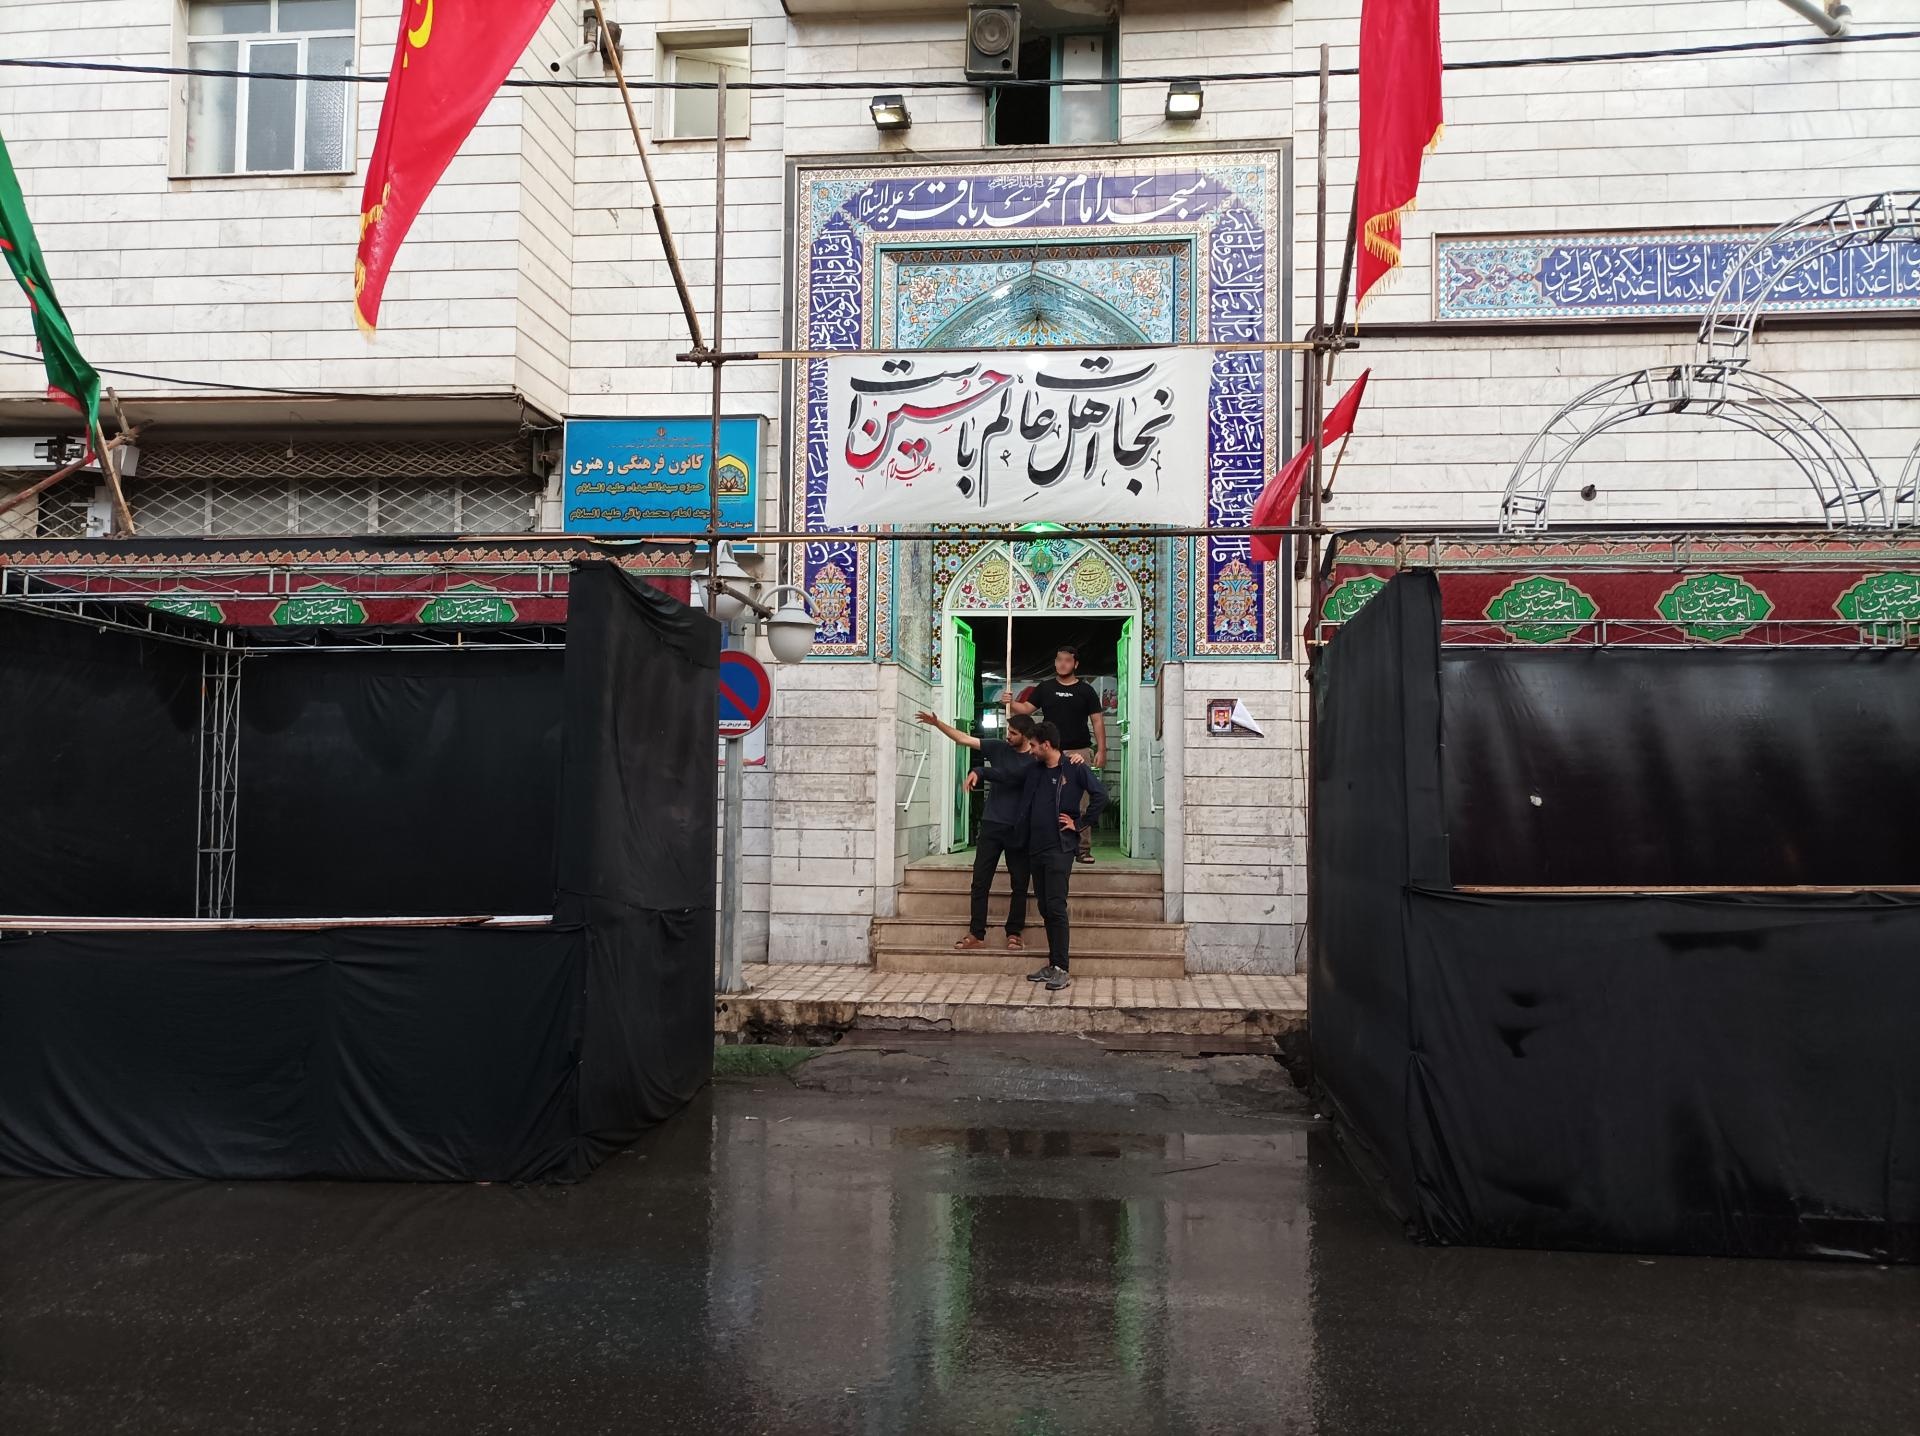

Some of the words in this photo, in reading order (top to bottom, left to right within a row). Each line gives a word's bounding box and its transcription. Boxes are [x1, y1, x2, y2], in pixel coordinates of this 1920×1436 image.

[887, 179, 978, 229] باقر
[973, 175, 1068, 227] محمد
[1061, 173, 1104, 226] امام
[1096, 177, 1207, 225] مسجد
[848, 359, 982, 431] است
[845, 369, 1014, 471] حسین
[1035, 356, 1174, 497] نجات
[978, 387, 1057, 508] عالم
[1027, 394, 1111, 487] اهل
[570, 456, 604, 475] هنری
[606, 460, 614, 475] و
[617, 453, 665, 475] فرهنگی
[668, 453, 704, 475] کانون
[956, 420, 978, 496] با
[575, 482, 606, 497] السلام
[606, 483, 626, 496] علیه
[570, 508, 601, 522] السلام
[602, 508, 622, 521] علیه
[622, 507, 642, 522] باقر
[642, 507, 670, 520] محمد
[670, 507, 693, 521] امام
